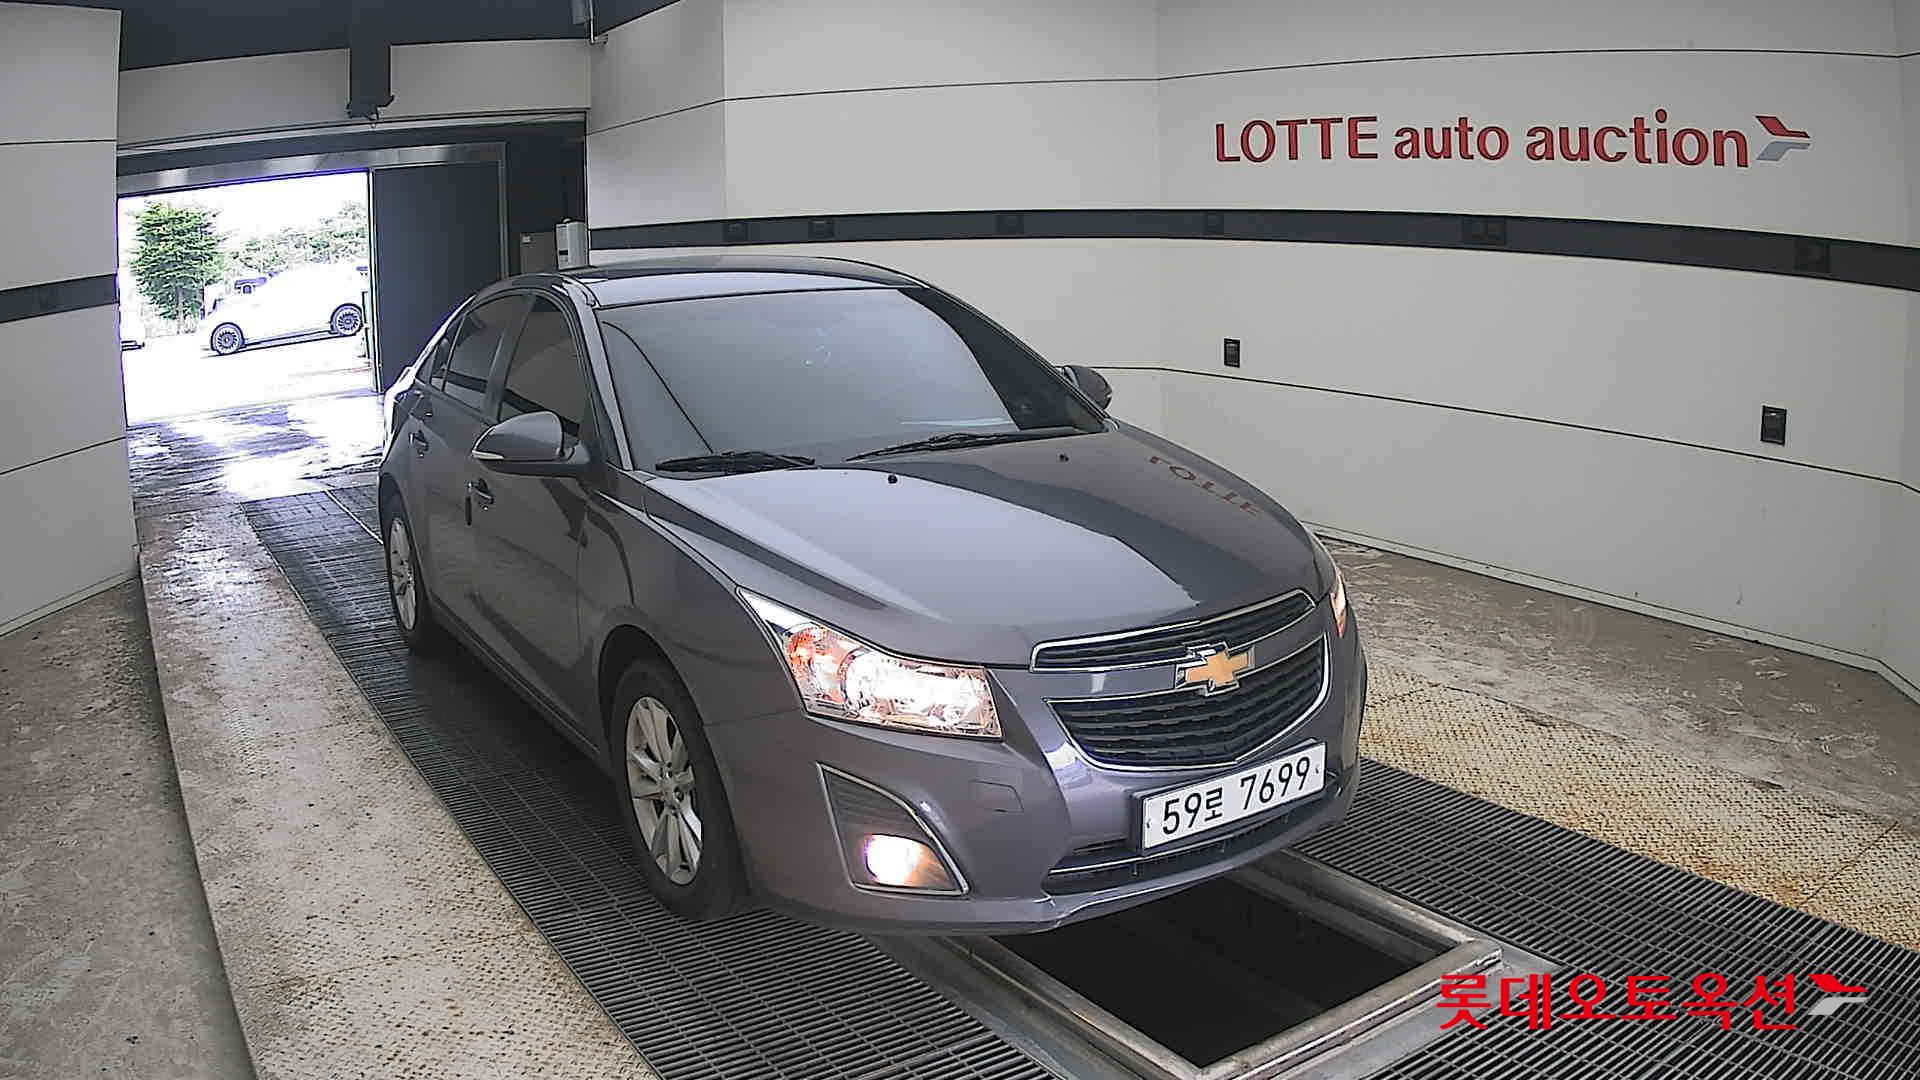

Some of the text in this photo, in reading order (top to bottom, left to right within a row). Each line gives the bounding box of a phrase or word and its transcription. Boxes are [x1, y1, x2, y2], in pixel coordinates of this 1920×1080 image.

[1215, 108, 1749, 168] LOTTE auto auction
[1162, 756, 1311, 835] 59로 7699
